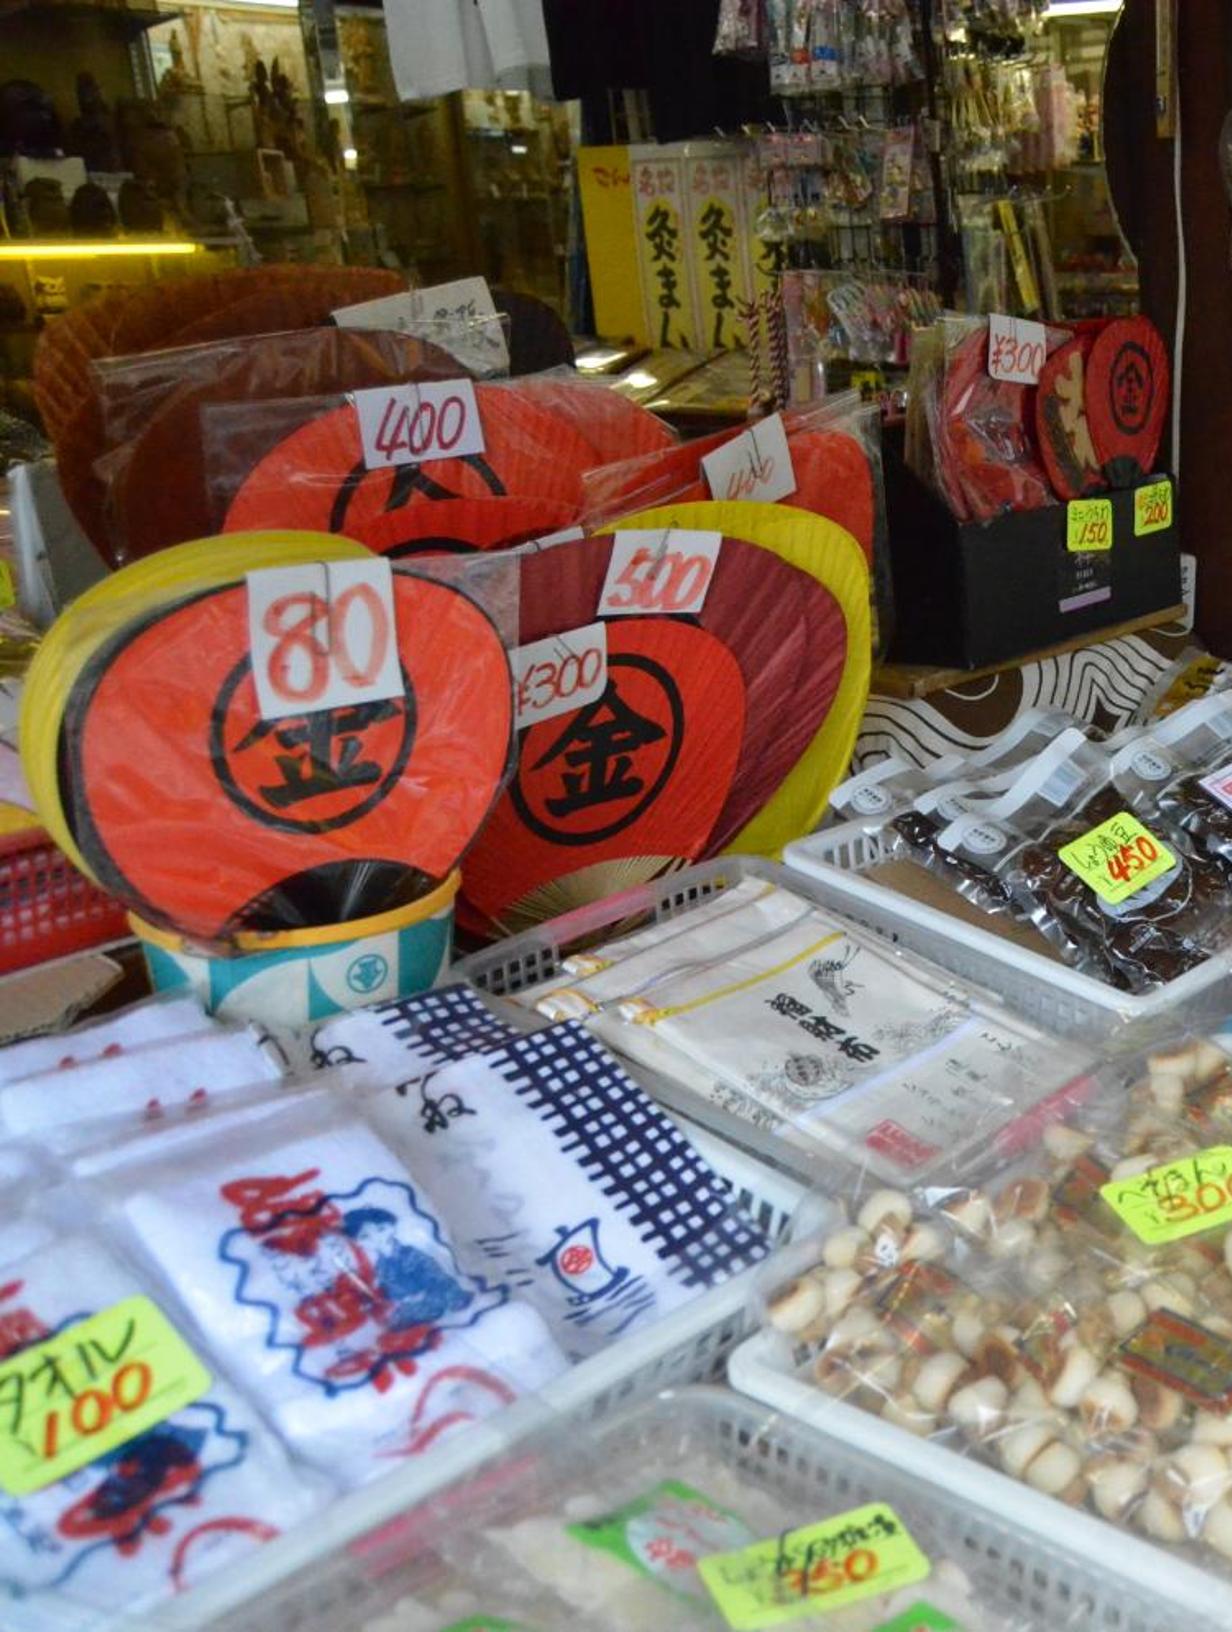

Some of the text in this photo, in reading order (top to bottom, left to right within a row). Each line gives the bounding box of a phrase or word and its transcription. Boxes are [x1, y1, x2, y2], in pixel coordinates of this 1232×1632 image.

[991, 333, 1044, 377] ¥300
[375, 395, 467, 461] 400
[606, 546, 712, 611] 500
[262, 581, 390, 705] 80
[515, 648, 602, 717] ¥300
[528, 678, 669, 818] 金
[0, 1317, 136, 1437] タオル
[44, 1361, 153, 1463] 100
